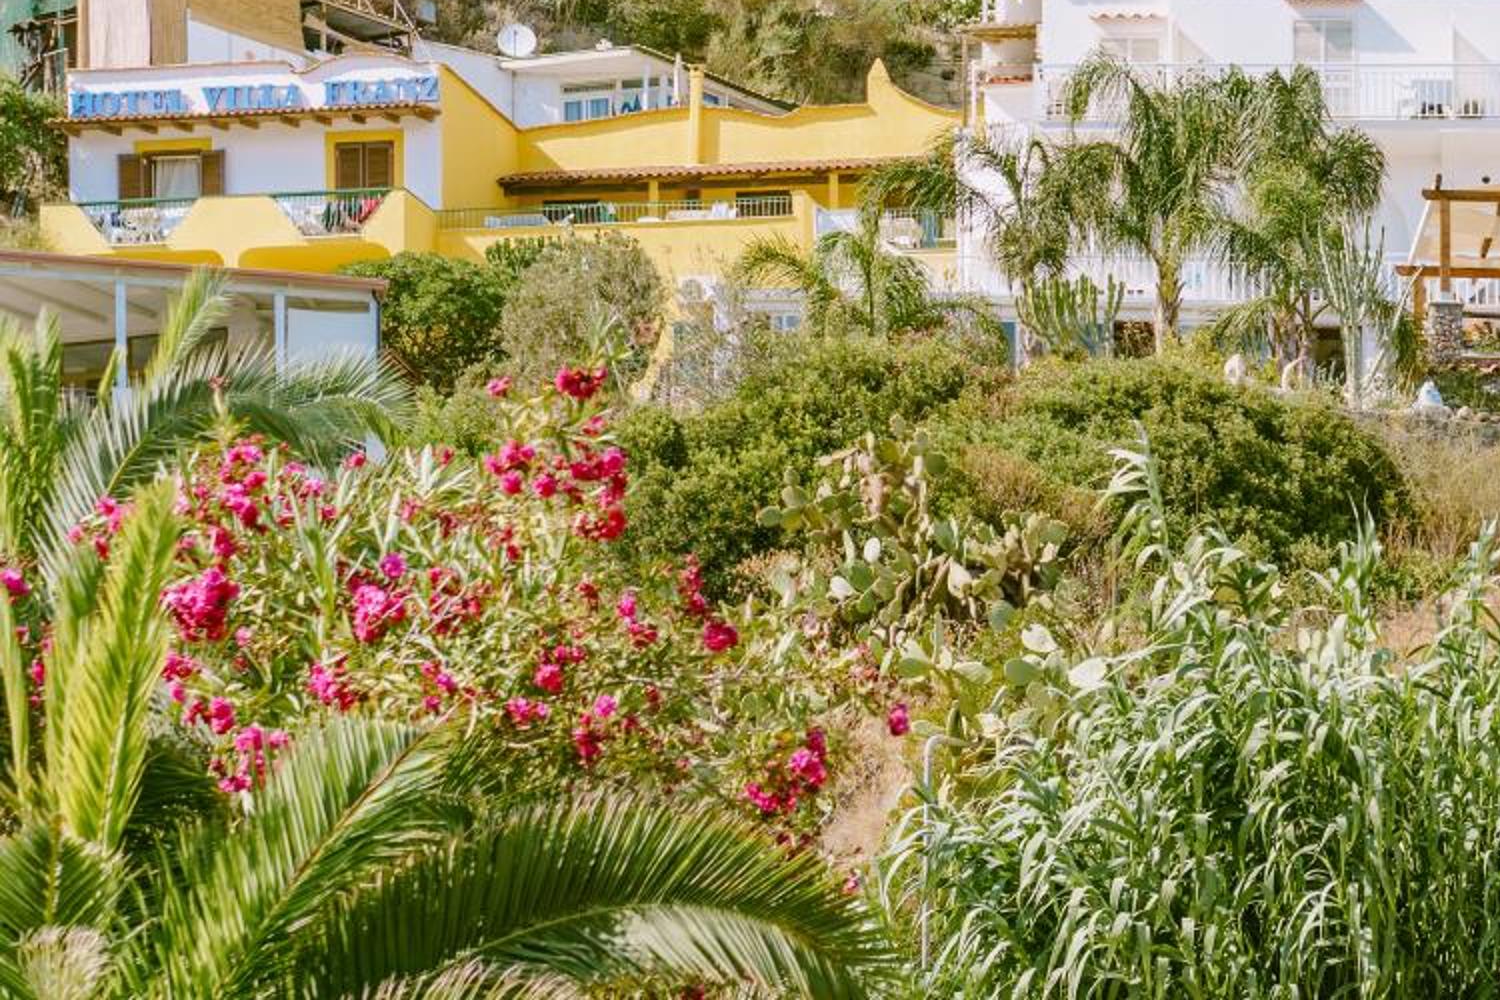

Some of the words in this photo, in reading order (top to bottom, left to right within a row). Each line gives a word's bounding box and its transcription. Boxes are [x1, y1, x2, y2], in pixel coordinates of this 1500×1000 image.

[71, 89, 187, 117] HOTEL
[202, 84, 301, 111] VILLA
[324, 76, 440, 105] FRANZ
